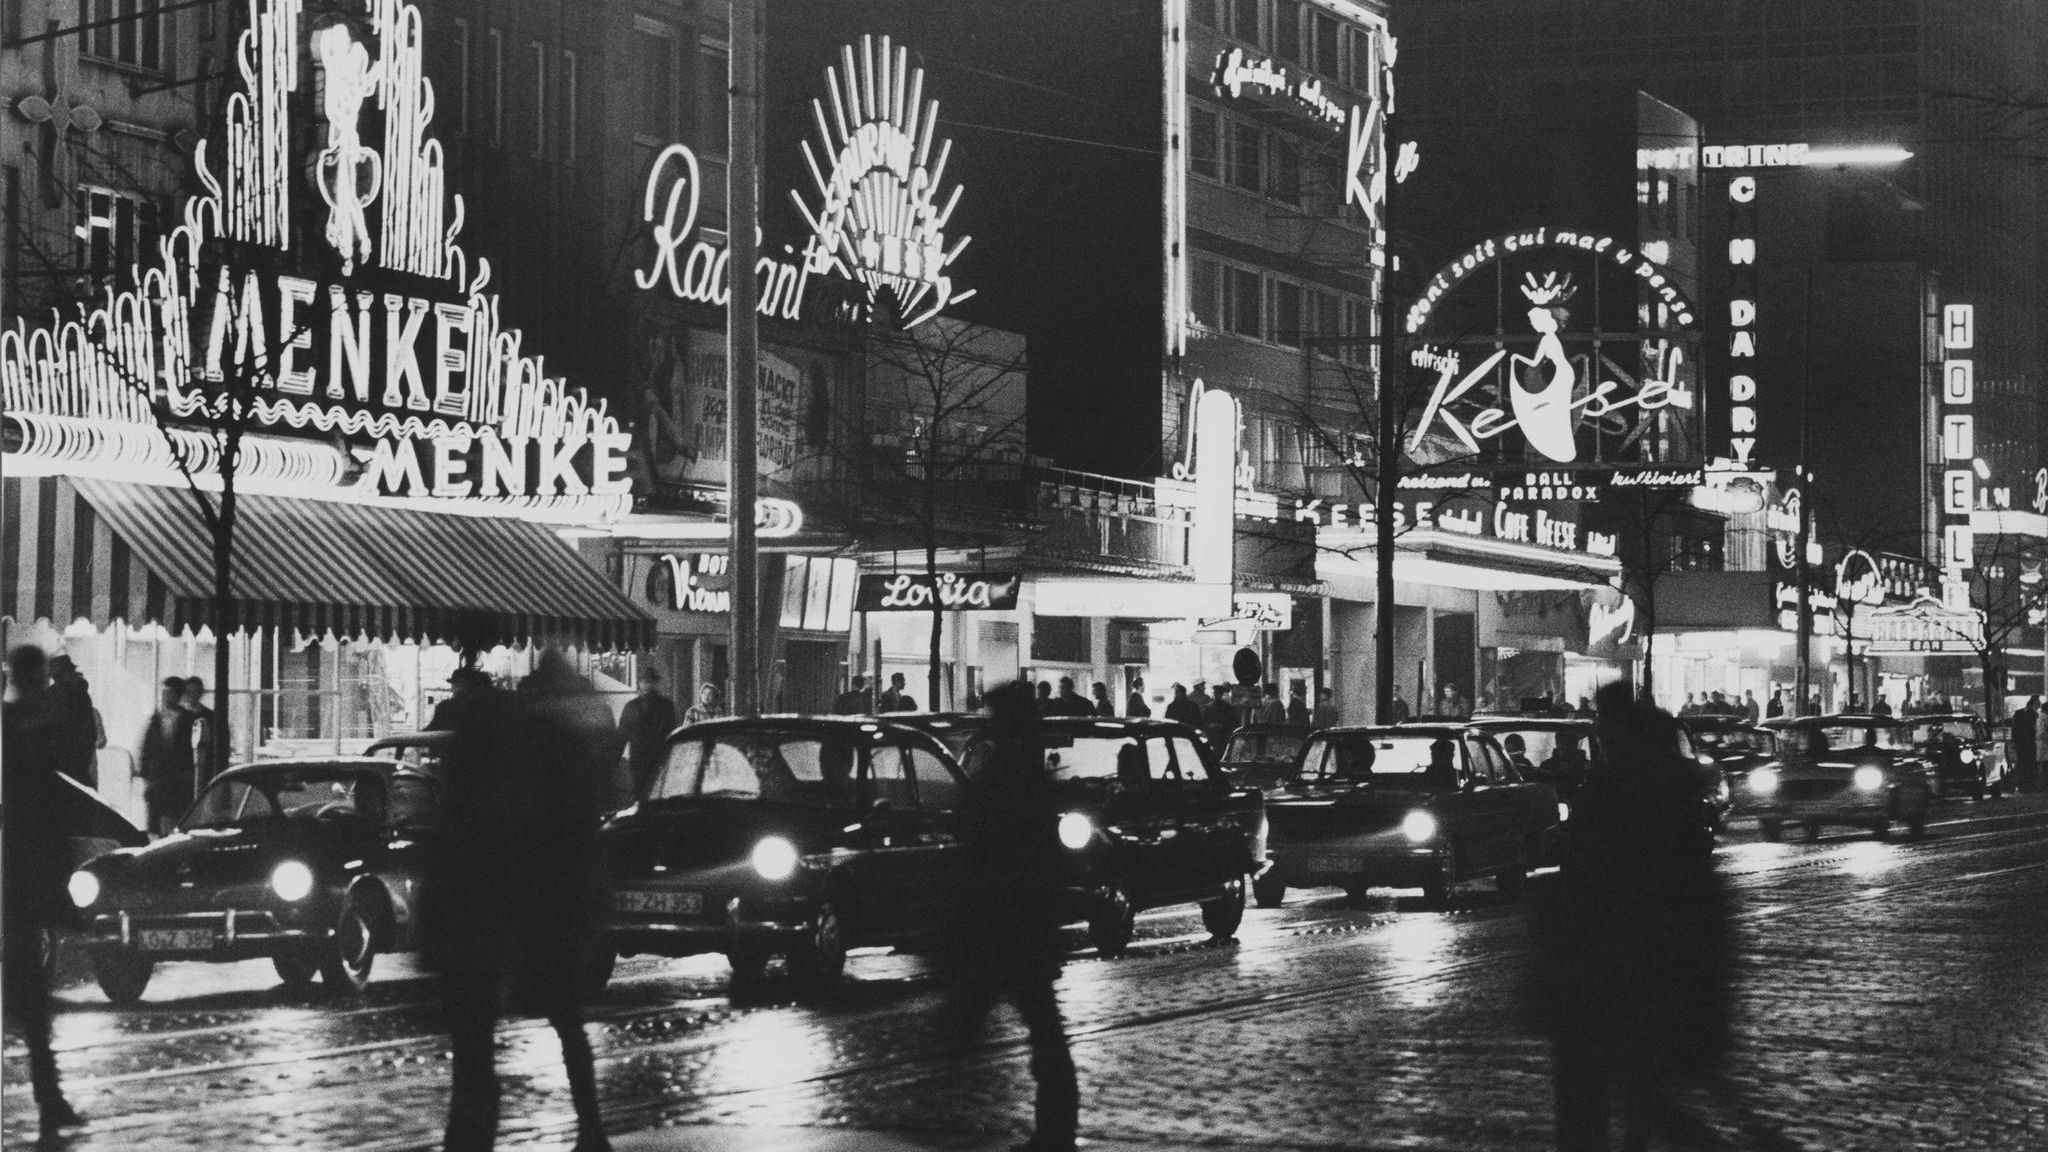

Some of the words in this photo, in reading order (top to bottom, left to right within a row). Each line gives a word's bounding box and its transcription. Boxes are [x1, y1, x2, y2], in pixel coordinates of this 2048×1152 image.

[634, 143, 817, 321] Radant
[1451, 239, 1495, 277] soit
[1555, 232, 1612, 252] mal
[1729, 176, 1756, 358] CNDA
[206, 263, 470, 417] MENKE
[1730, 374, 1757, 463] DRY
[1947, 306, 1970, 566] HOTEL
[371, 433, 632, 498] MENKE
[1501, 486, 1597, 499] PARADOX
[1526, 472, 1573, 486] BALL
[1295, 499, 1434, 530] KEESE
[698, 553, 730, 575] HOT
